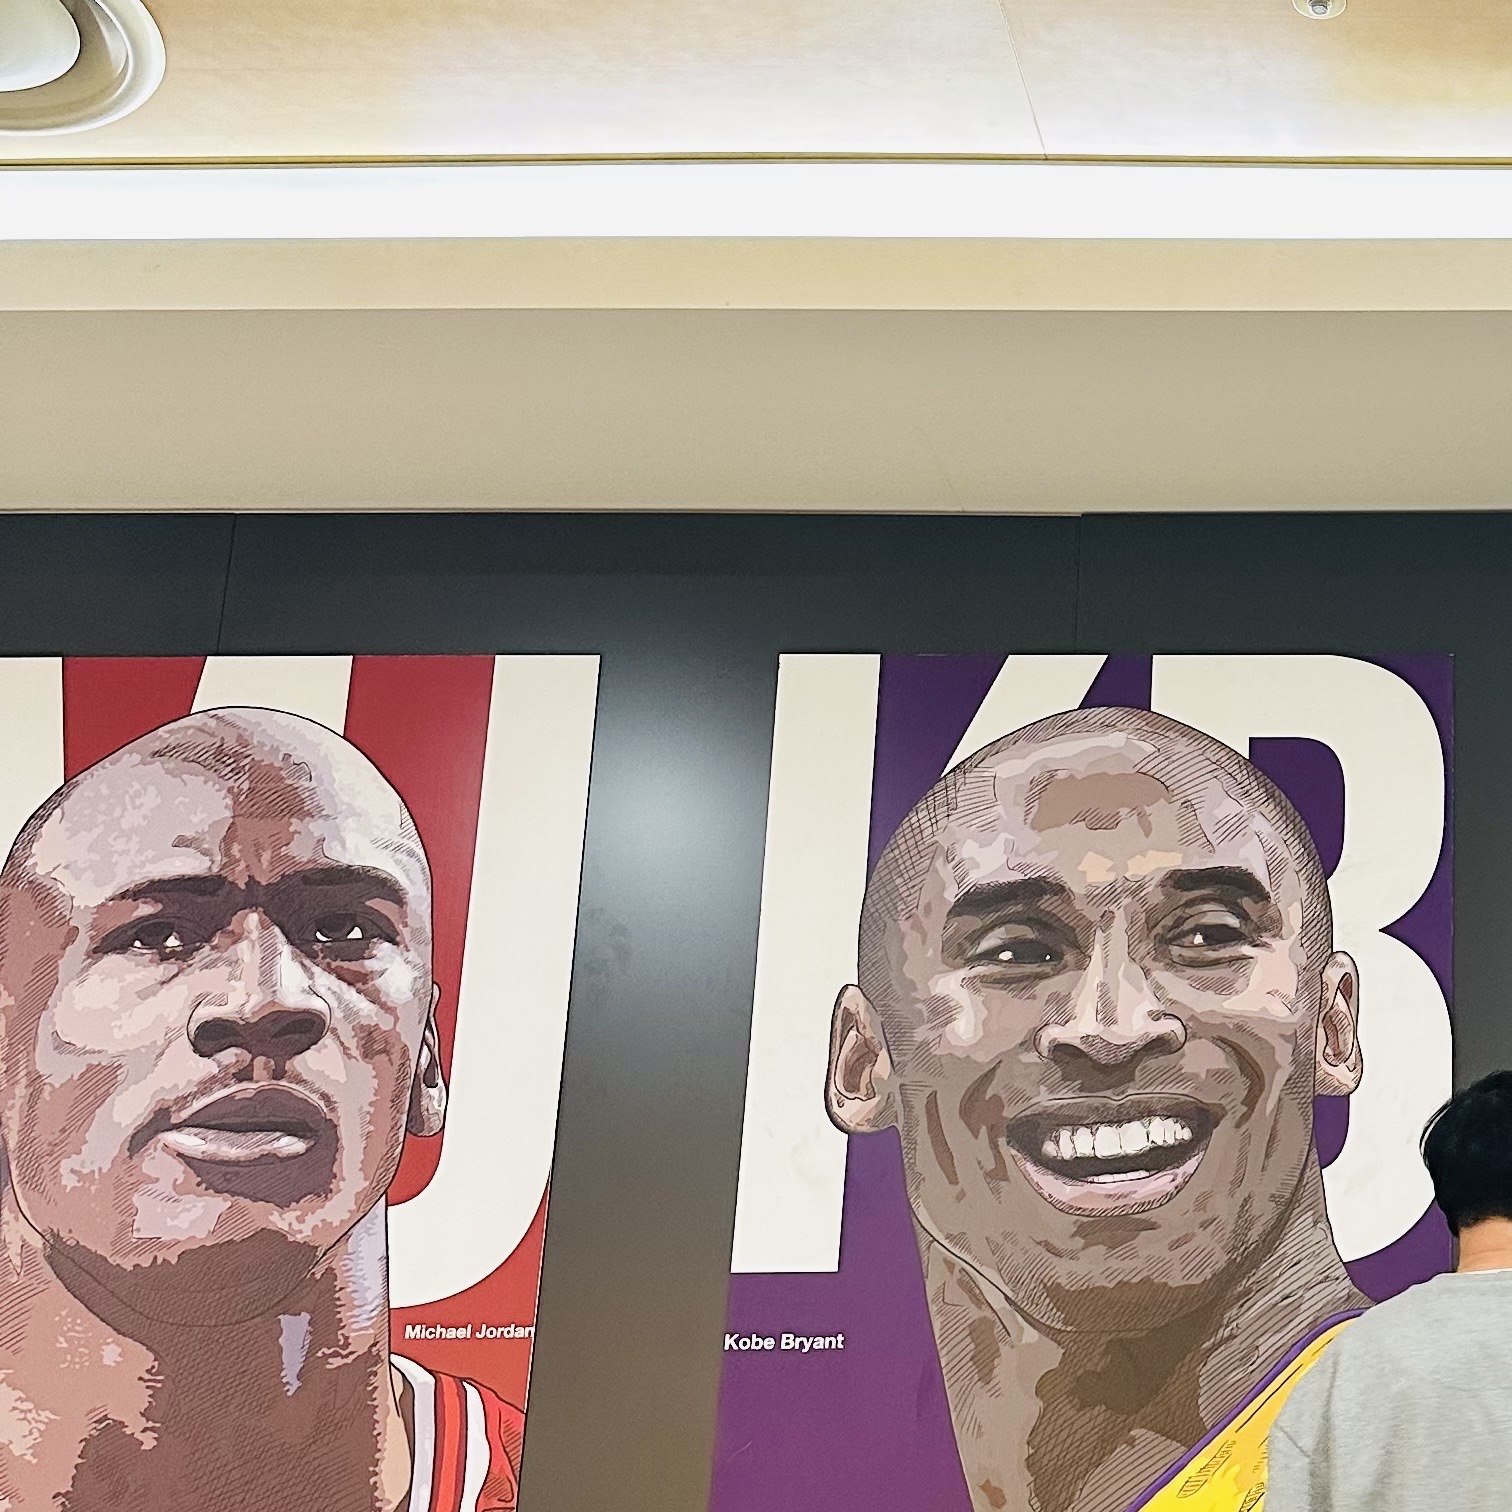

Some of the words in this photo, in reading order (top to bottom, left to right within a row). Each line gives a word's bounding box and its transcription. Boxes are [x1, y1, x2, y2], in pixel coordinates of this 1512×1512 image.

[404, 1323, 472, 1340] Michael
[475, 1323, 535, 1340] Jordan
[723, 1333, 776, 1351] Kobe
[780, 1333, 845, 1353] Bryant
